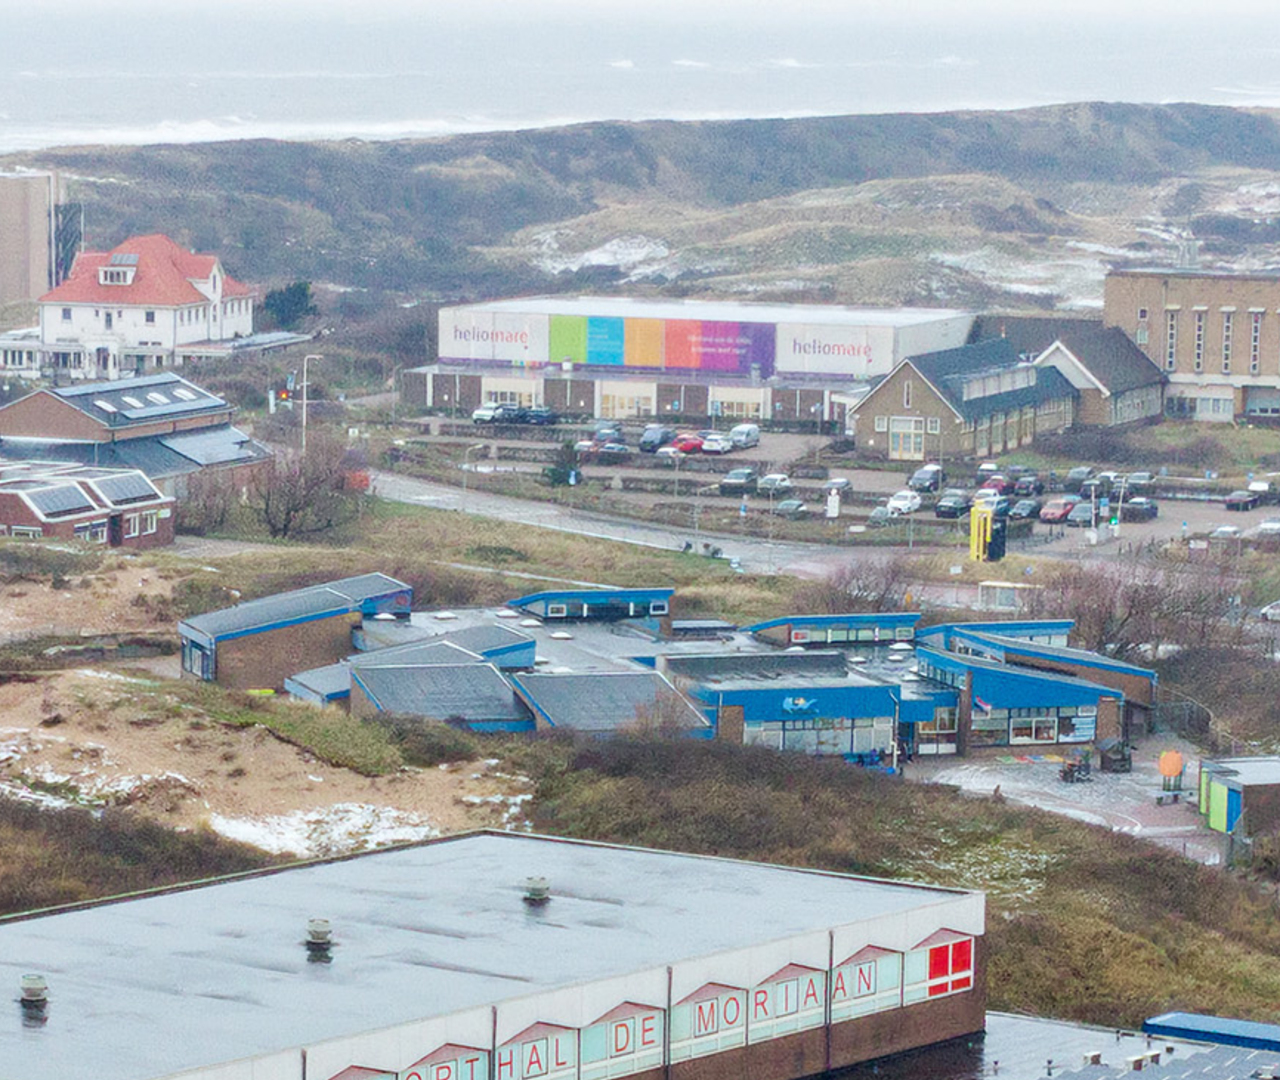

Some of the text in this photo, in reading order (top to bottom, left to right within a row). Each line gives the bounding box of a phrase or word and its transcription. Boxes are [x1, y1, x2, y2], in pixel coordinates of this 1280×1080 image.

[453, 325, 528, 345] heliomare
[793, 339, 872, 358] heliomare
[614, 1015, 656, 1053] DE
[697, 965, 873, 1036] MORIAAN
